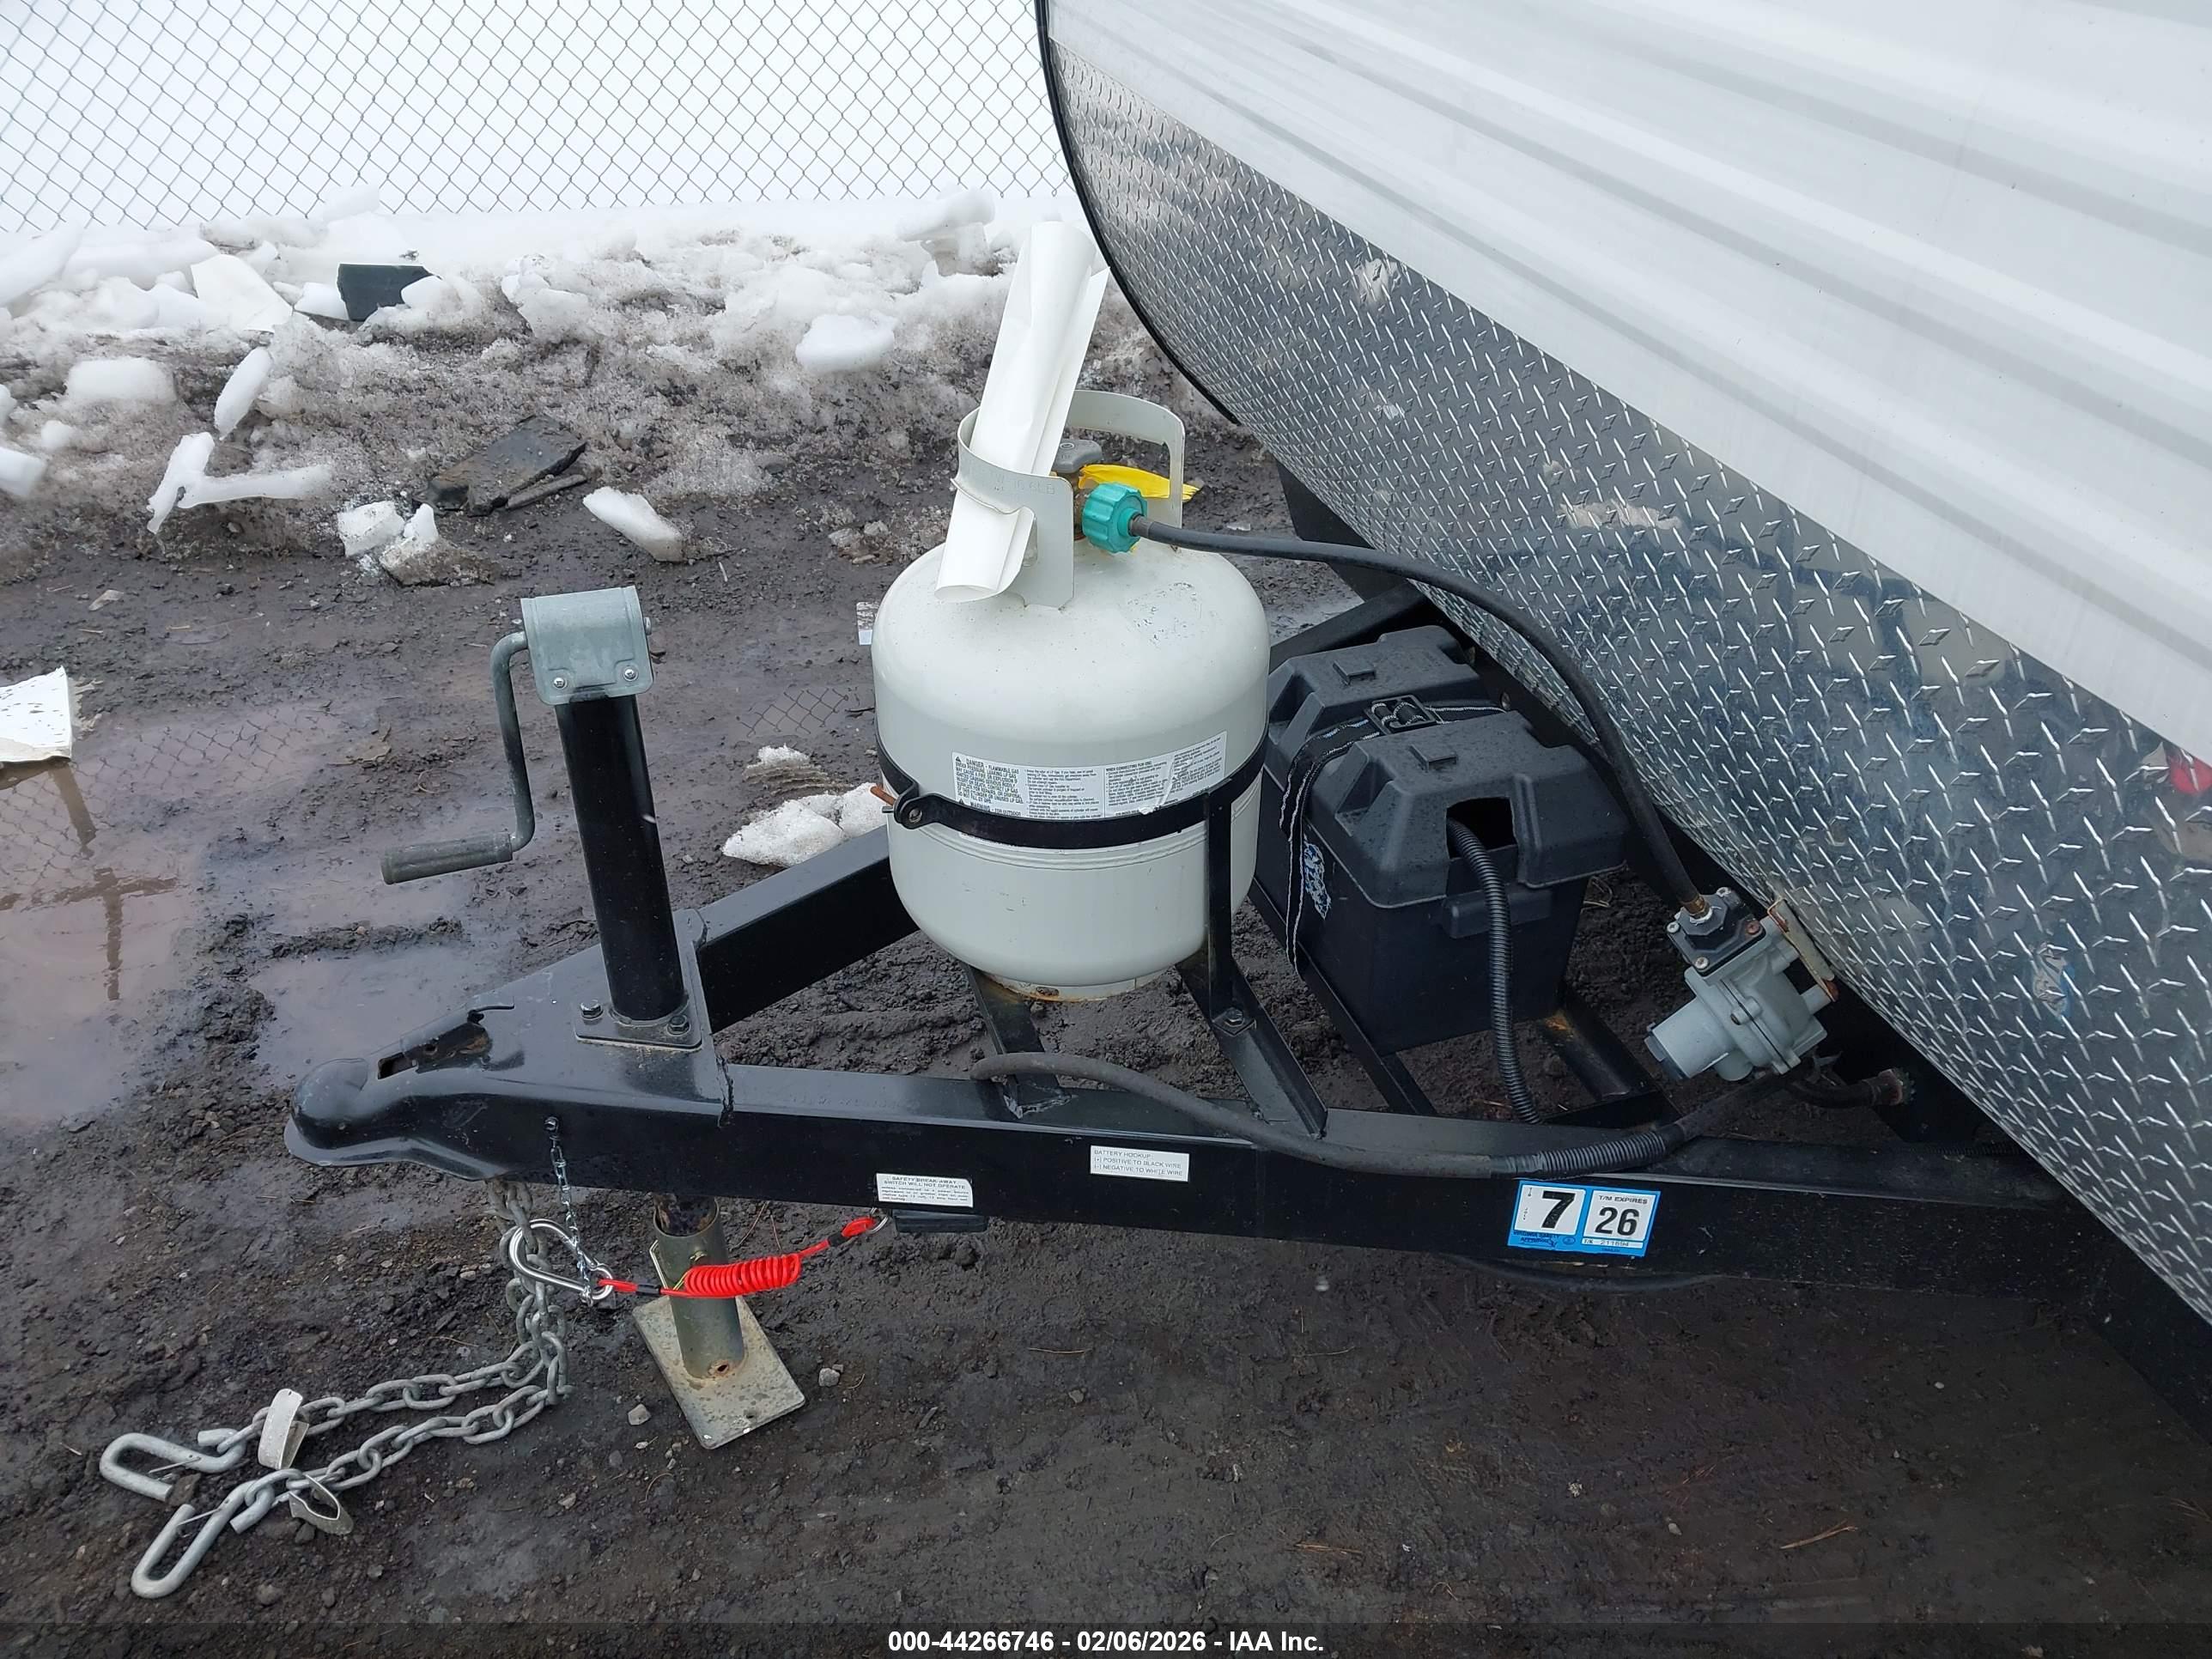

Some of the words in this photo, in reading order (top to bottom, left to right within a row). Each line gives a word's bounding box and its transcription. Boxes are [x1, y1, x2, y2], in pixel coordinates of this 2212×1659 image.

[966, 758, 983, 768] DANGER
[1541, 1190, 1576, 1229] 7
[1614, 1196, 1648, 1205] EXPIRES
[1595, 1206, 1640, 1236] 26
